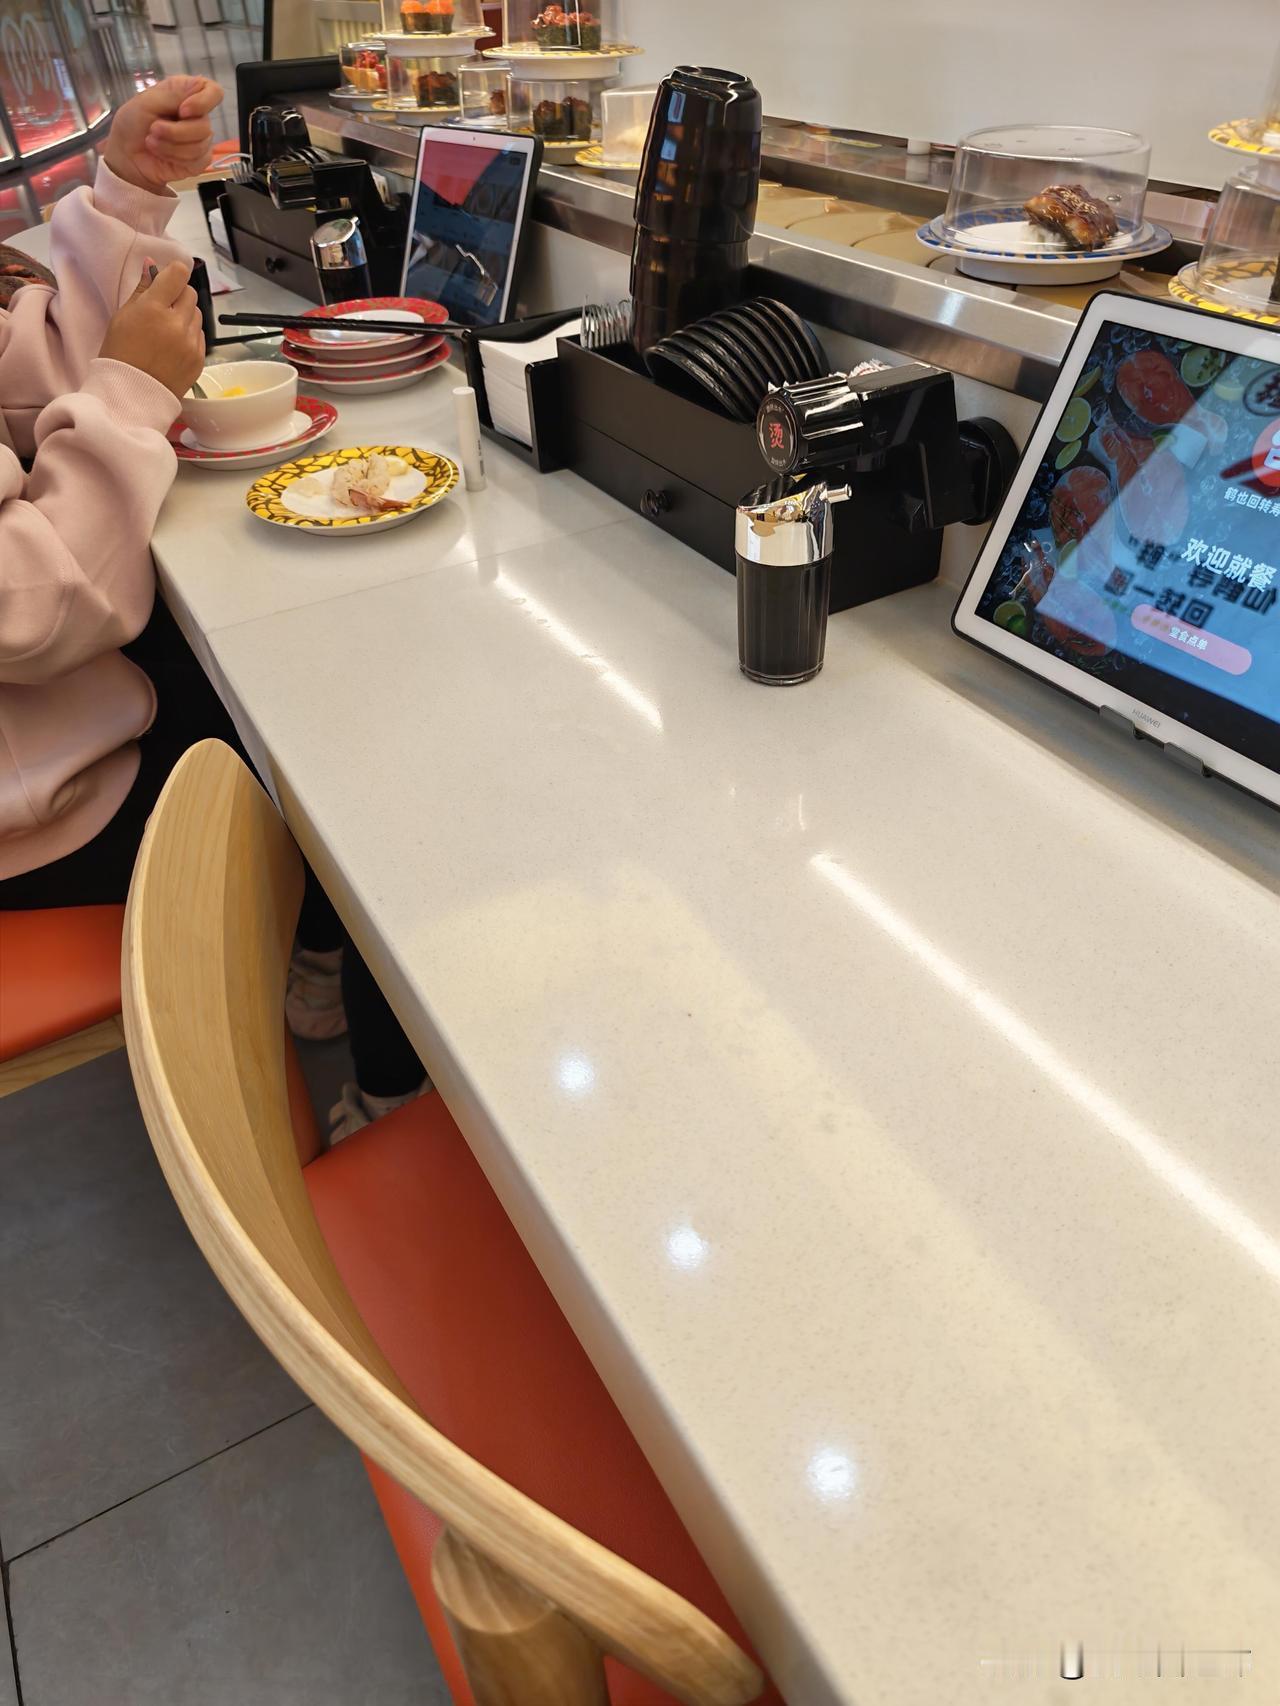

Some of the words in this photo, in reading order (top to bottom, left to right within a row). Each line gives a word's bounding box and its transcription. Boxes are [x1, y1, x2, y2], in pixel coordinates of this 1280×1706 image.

[768, 422, 785, 449] 烫
[1180, 537, 1277, 592] 欢迎就餐
[1169, 626, 1209, 651] 堂食点单
[1132, 708, 1161, 728] HUAWEI
